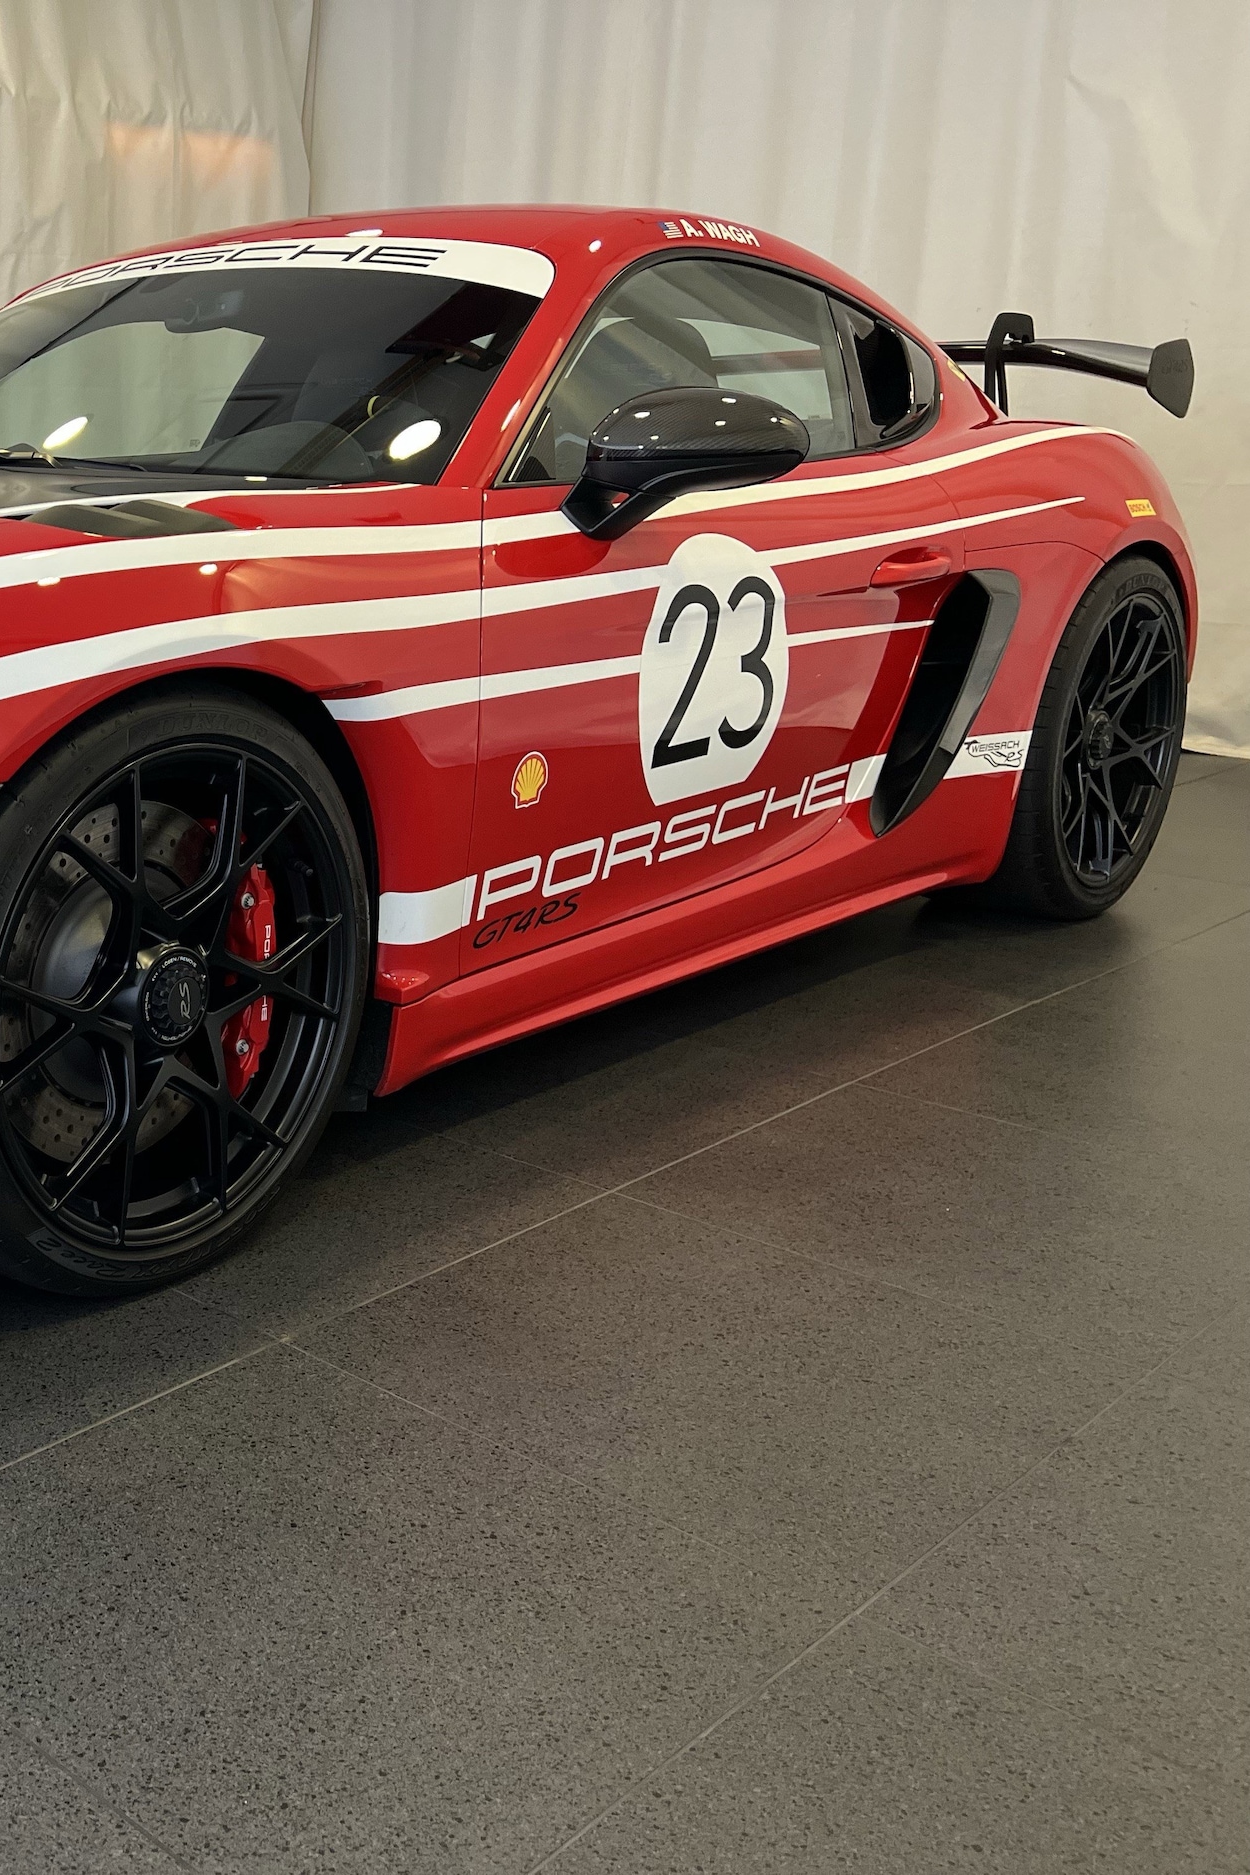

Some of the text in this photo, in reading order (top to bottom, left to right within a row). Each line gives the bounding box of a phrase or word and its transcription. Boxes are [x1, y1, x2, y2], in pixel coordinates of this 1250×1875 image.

[679, 218, 760, 247] A. WAGH
[16, 243, 448, 299] PORSCHE
[651, 576, 776, 770] 23
[157, 711, 268, 743] DUNLOP
[971, 740, 1020, 753] WEISSACH
[476, 763, 851, 922] PORSCHE
[179, 982, 191, 1019] RS
